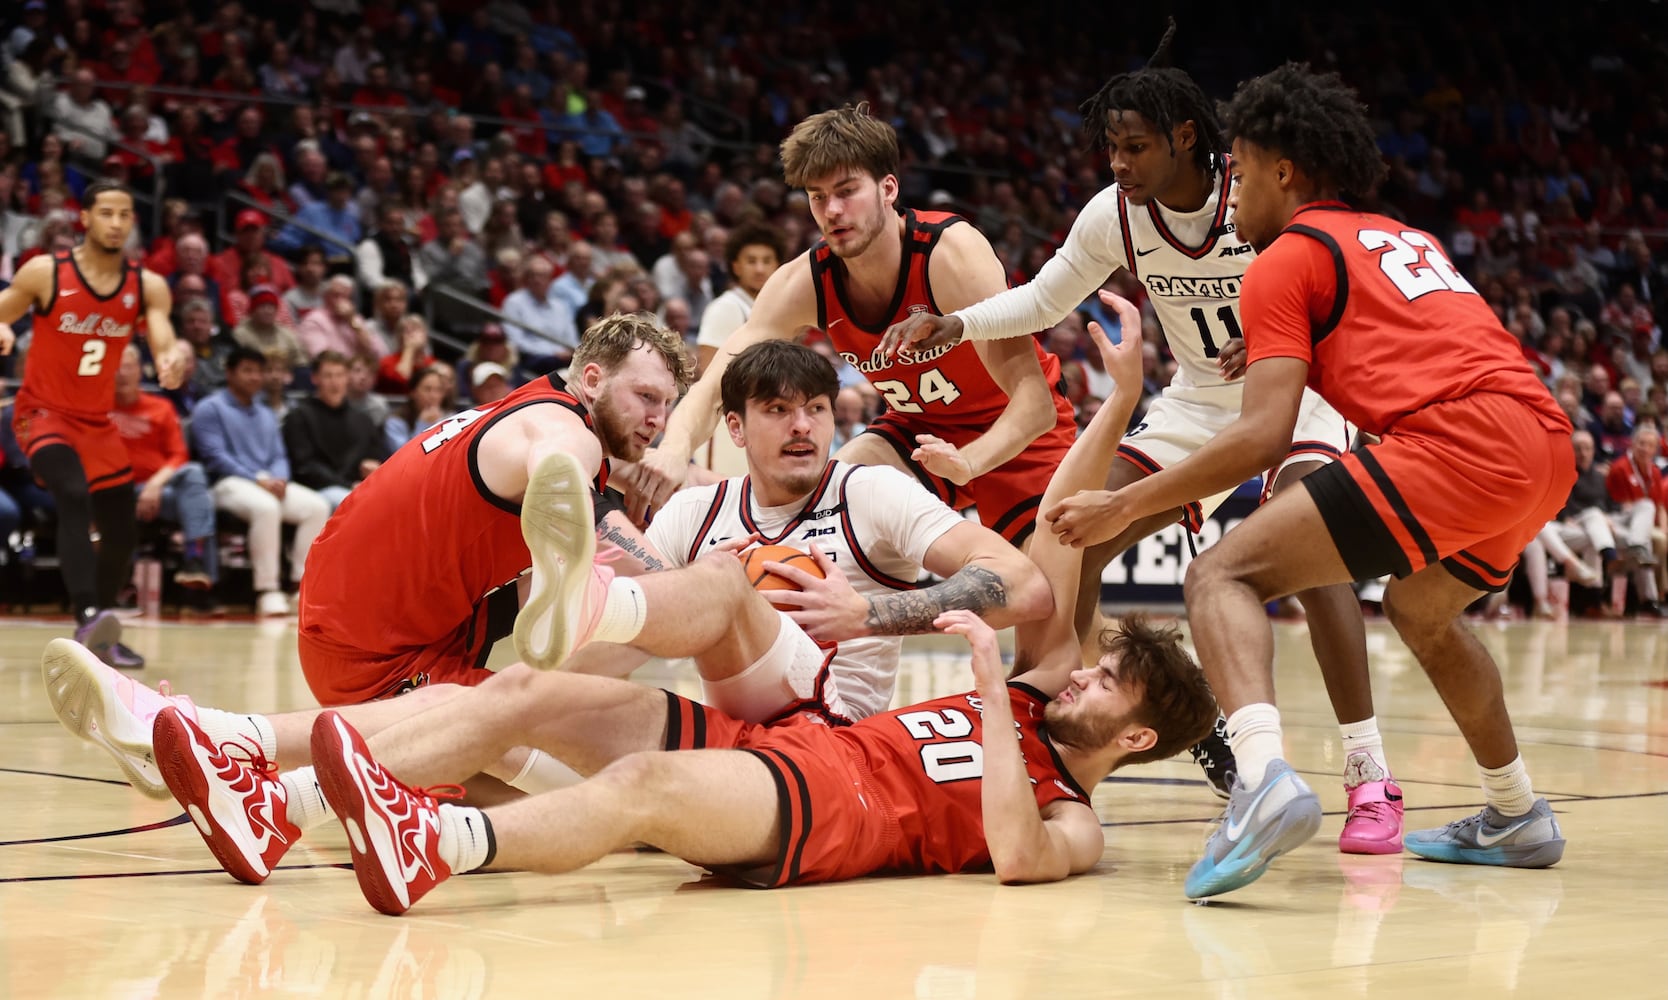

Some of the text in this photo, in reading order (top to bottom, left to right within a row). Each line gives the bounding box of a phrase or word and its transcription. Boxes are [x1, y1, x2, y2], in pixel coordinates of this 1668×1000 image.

[1146, 274, 1244, 299] DAYTO
[1357, 229, 1480, 302] 22
[1190, 305, 1243, 358] 11
[78, 339, 107, 376] 2
[872, 368, 961, 413] 24
[421, 407, 497, 455] 4
[815, 508, 833, 520] DJD
[895, 707, 984, 784] 20
